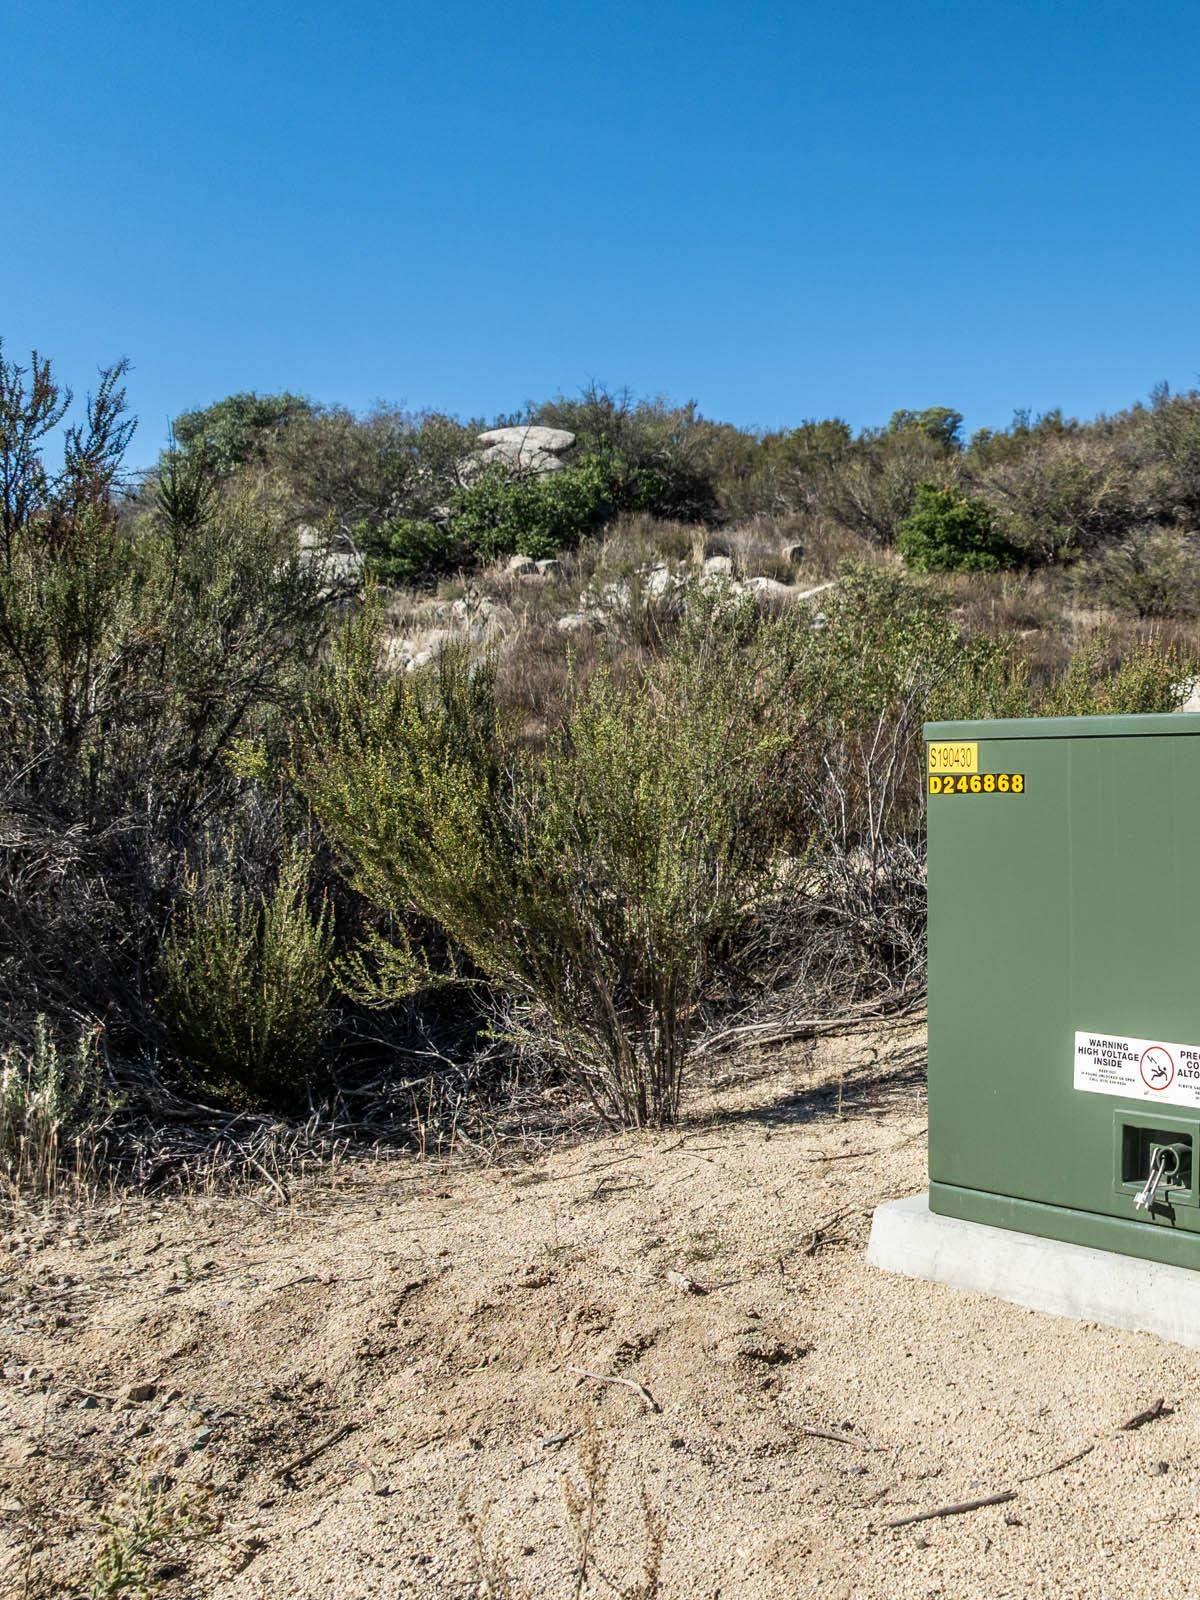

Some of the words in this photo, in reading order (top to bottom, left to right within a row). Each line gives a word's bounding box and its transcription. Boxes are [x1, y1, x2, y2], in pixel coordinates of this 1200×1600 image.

[930, 747, 972, 768] S190430
[929, 774, 1023, 794] D246868
[1089, 1038, 1129, 1051] WARNING
[1078, 1046, 1099, 1056] HIGH
[1101, 1049, 1140, 1062] VOLTAGE
[1094, 1057, 1123, 1069] INSIDE
[1177, 1068, 1200, 1079] ALTO
